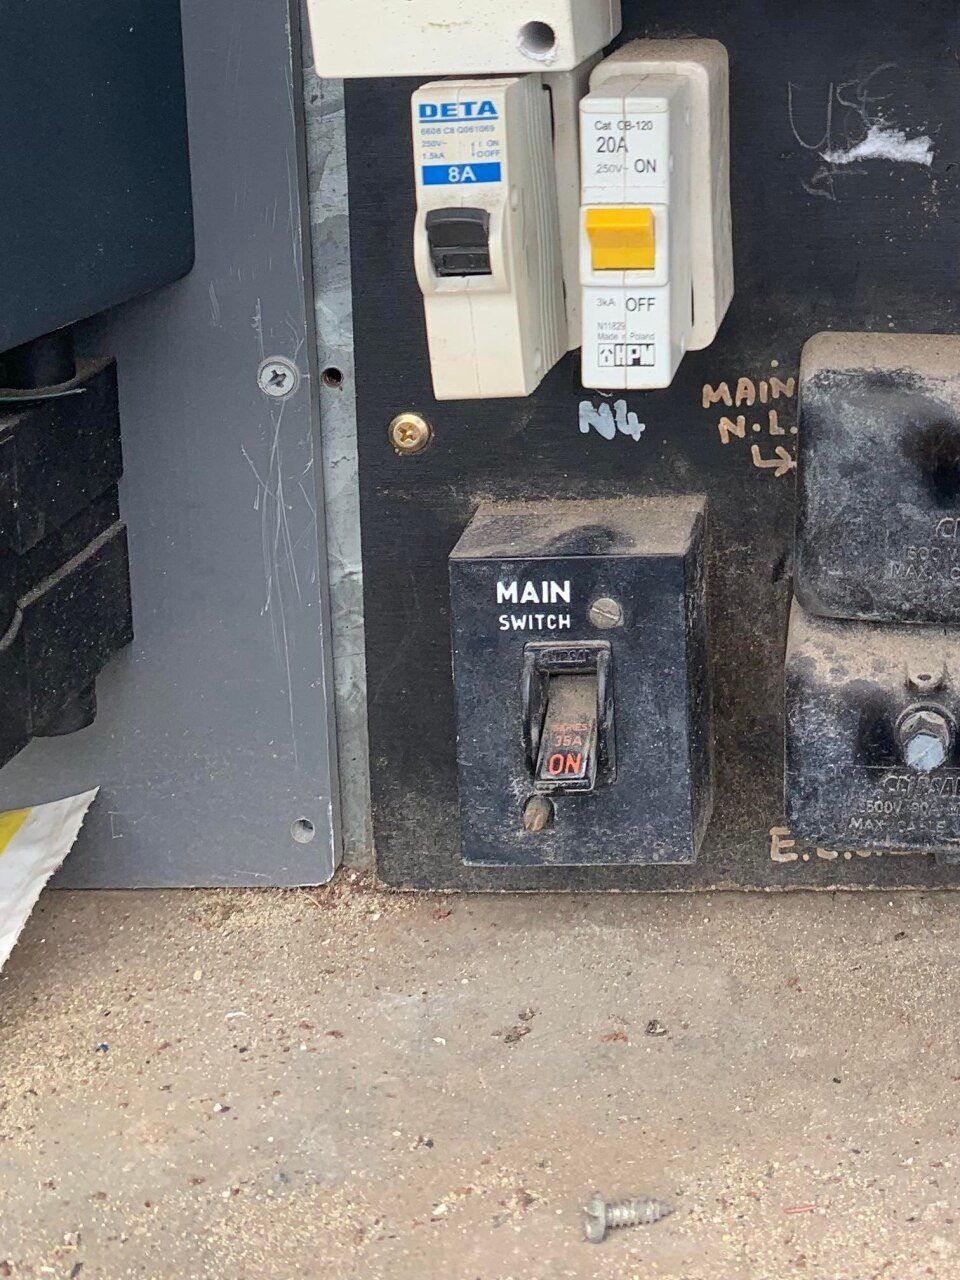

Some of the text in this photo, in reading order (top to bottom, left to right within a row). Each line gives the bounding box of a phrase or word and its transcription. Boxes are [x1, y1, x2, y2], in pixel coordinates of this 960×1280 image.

[419, 101, 497, 118] DETA
[594, 120, 653, 131] Cat CB-120
[596, 136, 628, 153] 20A
[448, 165, 477, 182] 8A
[634, 159, 656, 173] ON
[626, 297, 656, 312] OFF
[614, 343, 655, 367] HPM
[702, 376, 795, 409] MAIN
[578, 399, 646, 441] N4
[717, 409, 799, 444] N.L.
[496, 580, 571, 604] MAIN
[498, 614, 571, 631] SWITCH
[554, 734, 583, 747] 35A
[548, 753, 583, 776] ON
